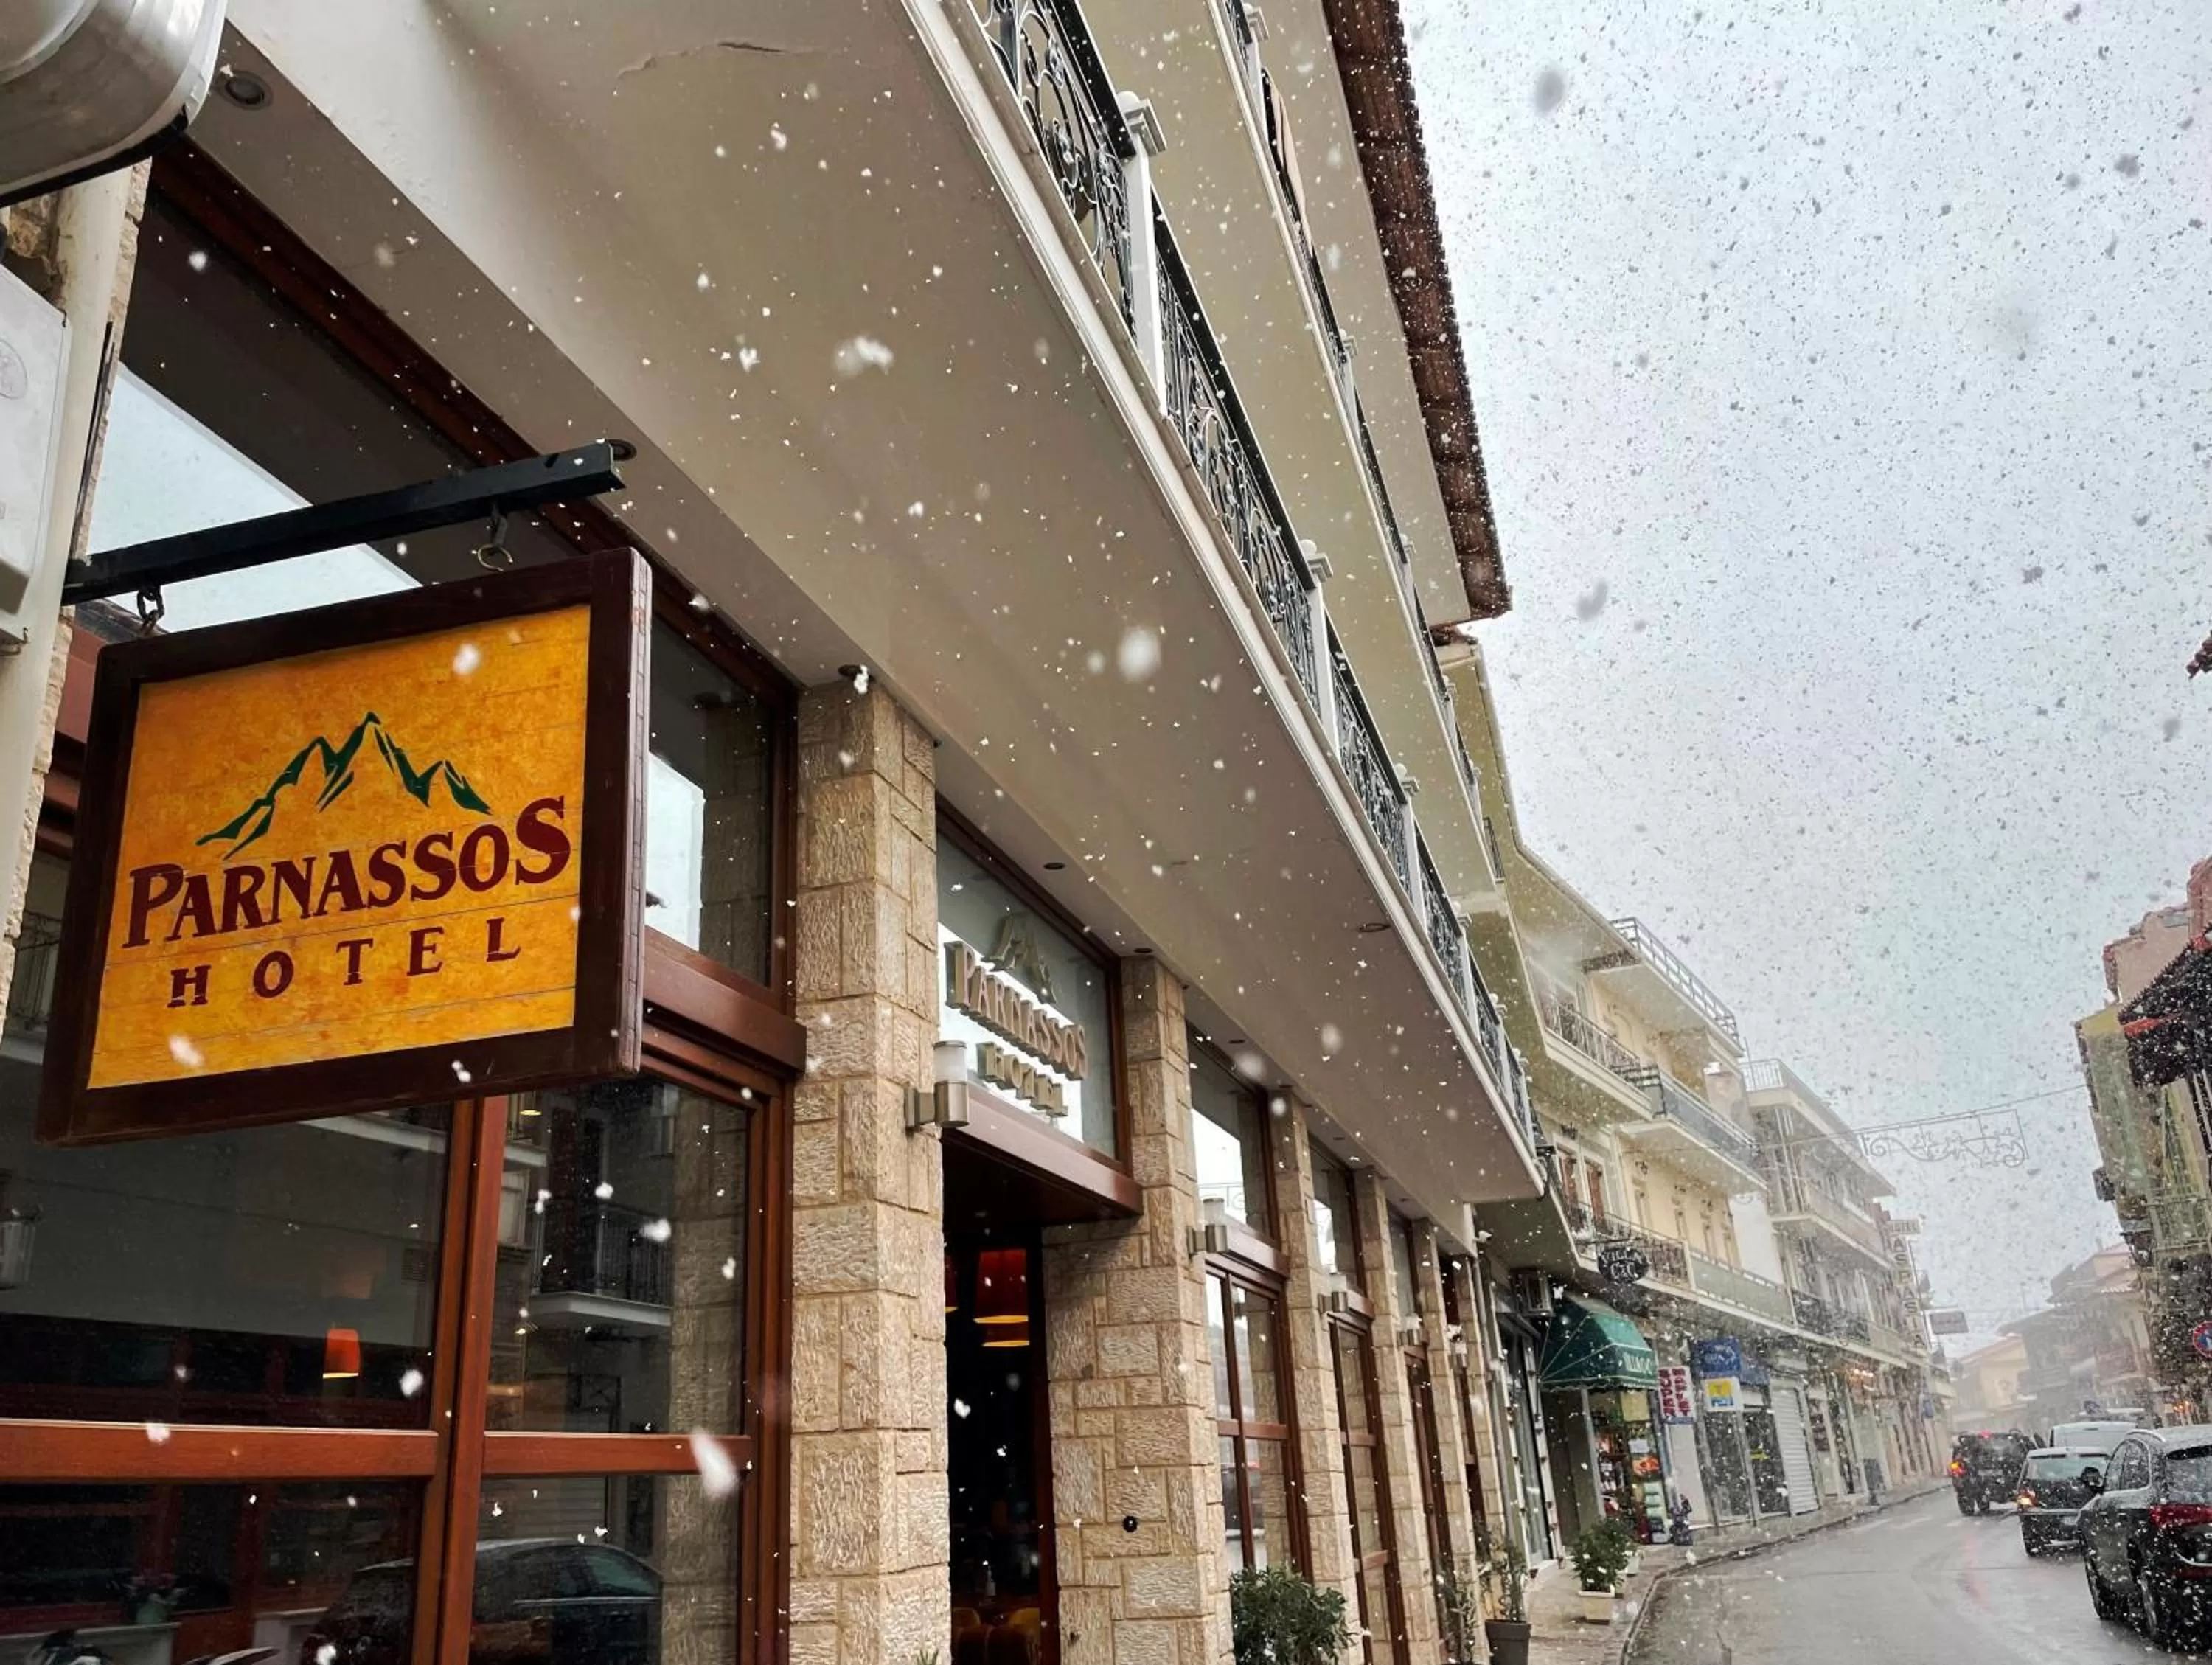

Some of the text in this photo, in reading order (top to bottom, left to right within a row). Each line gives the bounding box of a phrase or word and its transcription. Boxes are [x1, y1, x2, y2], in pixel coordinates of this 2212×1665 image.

[122, 796, 571, 949] PARNASSOS
[167, 917, 521, 1008] HOTEL
[945, 941, 1088, 1081] PARNASSOS
